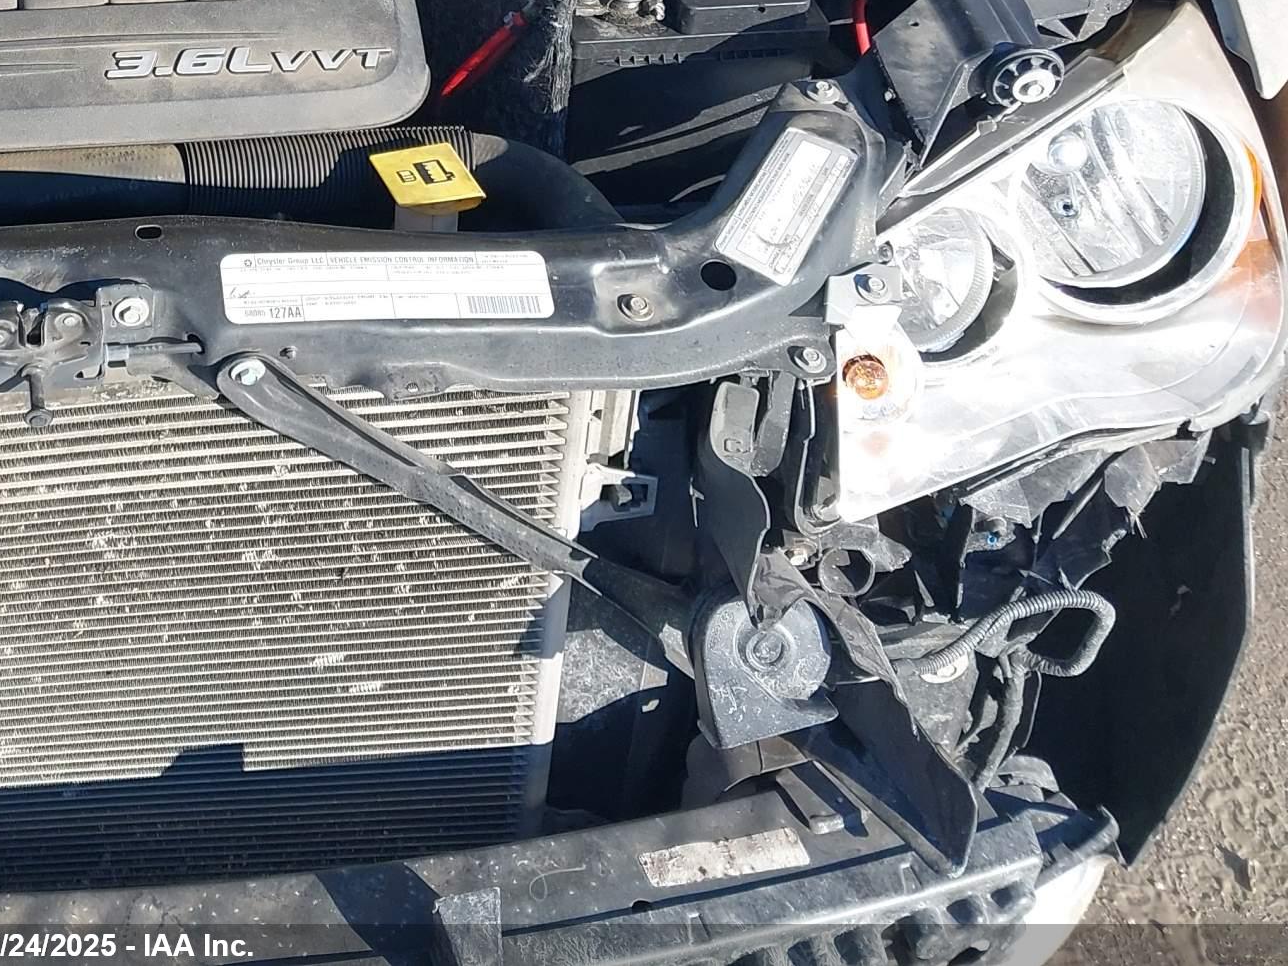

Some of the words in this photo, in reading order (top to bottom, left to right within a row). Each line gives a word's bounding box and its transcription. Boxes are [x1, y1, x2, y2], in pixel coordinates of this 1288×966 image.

[257, 257, 286, 266] Chrysler
[329, 256, 358, 264] VEHICLE
[360, 256, 393, 264] EMISSION
[394, 256, 425, 264] CONTROL
[426, 256, 474, 264] INFORMATION
[268, 306, 302, 319] 127AA
